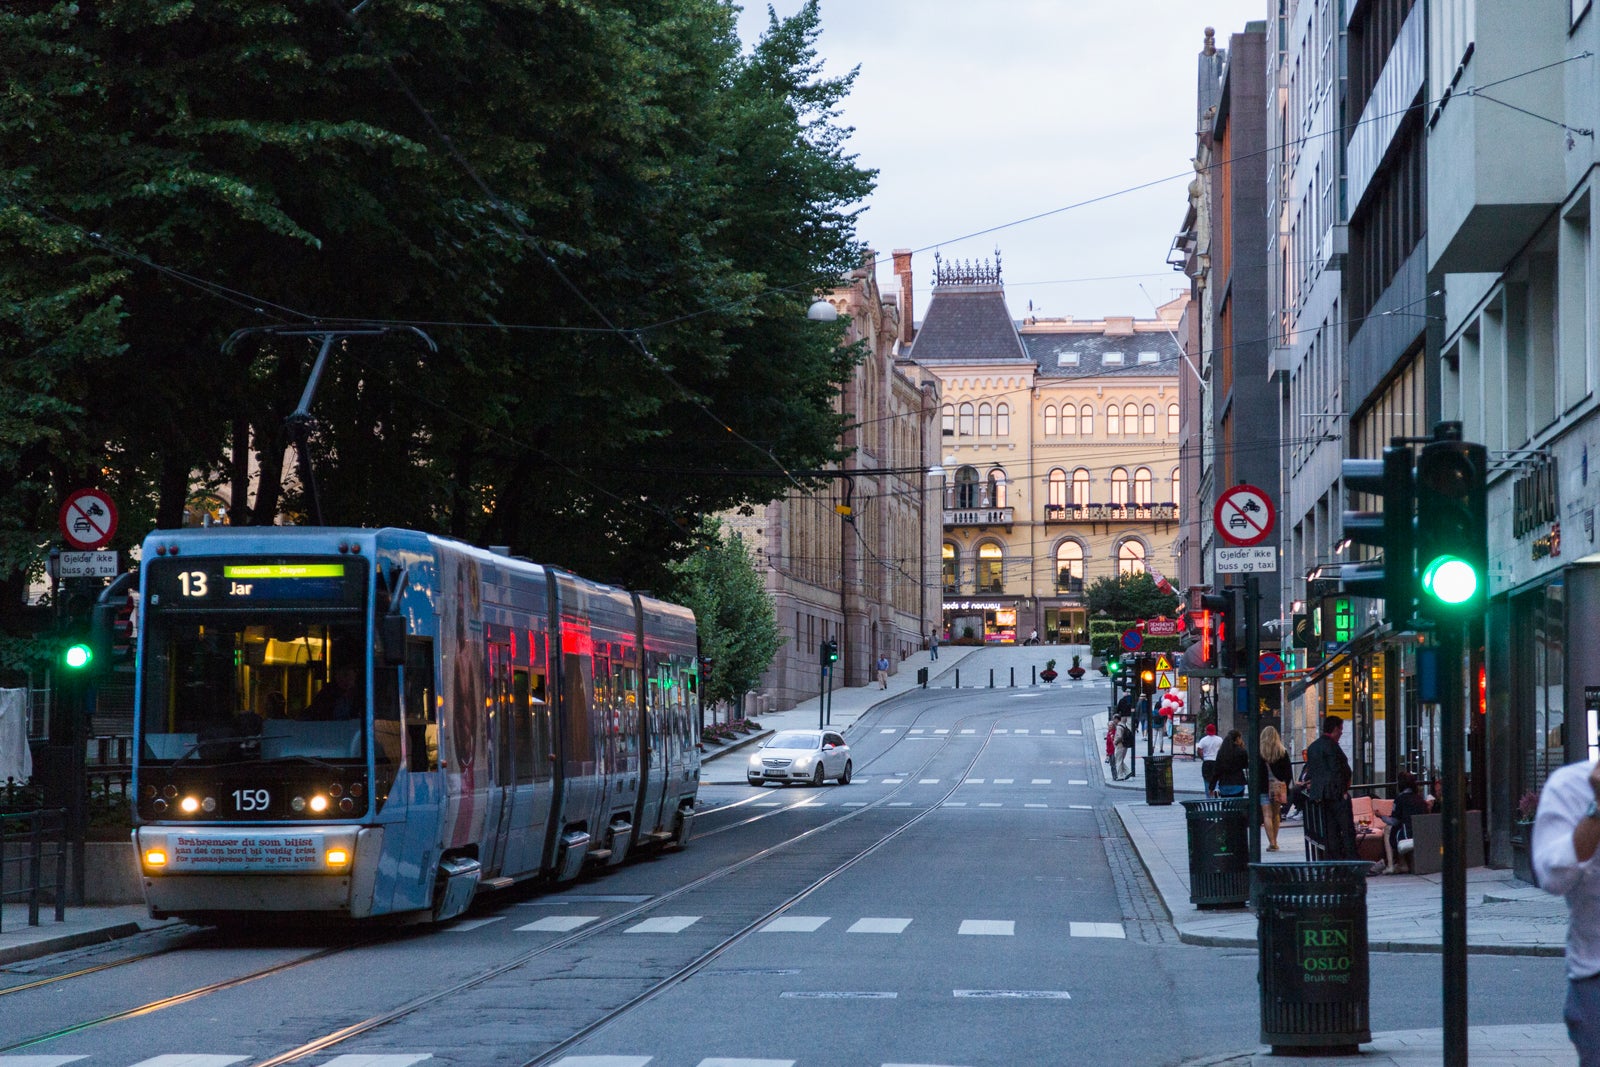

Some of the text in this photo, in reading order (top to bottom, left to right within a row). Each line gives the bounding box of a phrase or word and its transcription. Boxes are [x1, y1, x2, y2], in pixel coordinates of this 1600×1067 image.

[63, 554, 113, 564] Gjelder ikke
[1220, 550, 1271, 560] Gjelder ikke
[61, 566, 115, 575] buss og taxi
[1218, 561, 1274, 571] buss og taxi
[177, 571, 208, 597] 13
[229, 582, 253, 596] Jar
[961, 601, 970, 610] of
[971, 602, 1001, 611] norway
[232, 789, 270, 811] 159
[242, 838, 255, 847] du
[259, 839, 281, 847] som
[284, 838, 313, 847] bilist
[265, 847, 292, 856] veldig
[1303, 929, 1348, 947] REN
[1303, 956, 1350, 971] OSLO
[1304, 973, 1326, 983] Bruk
